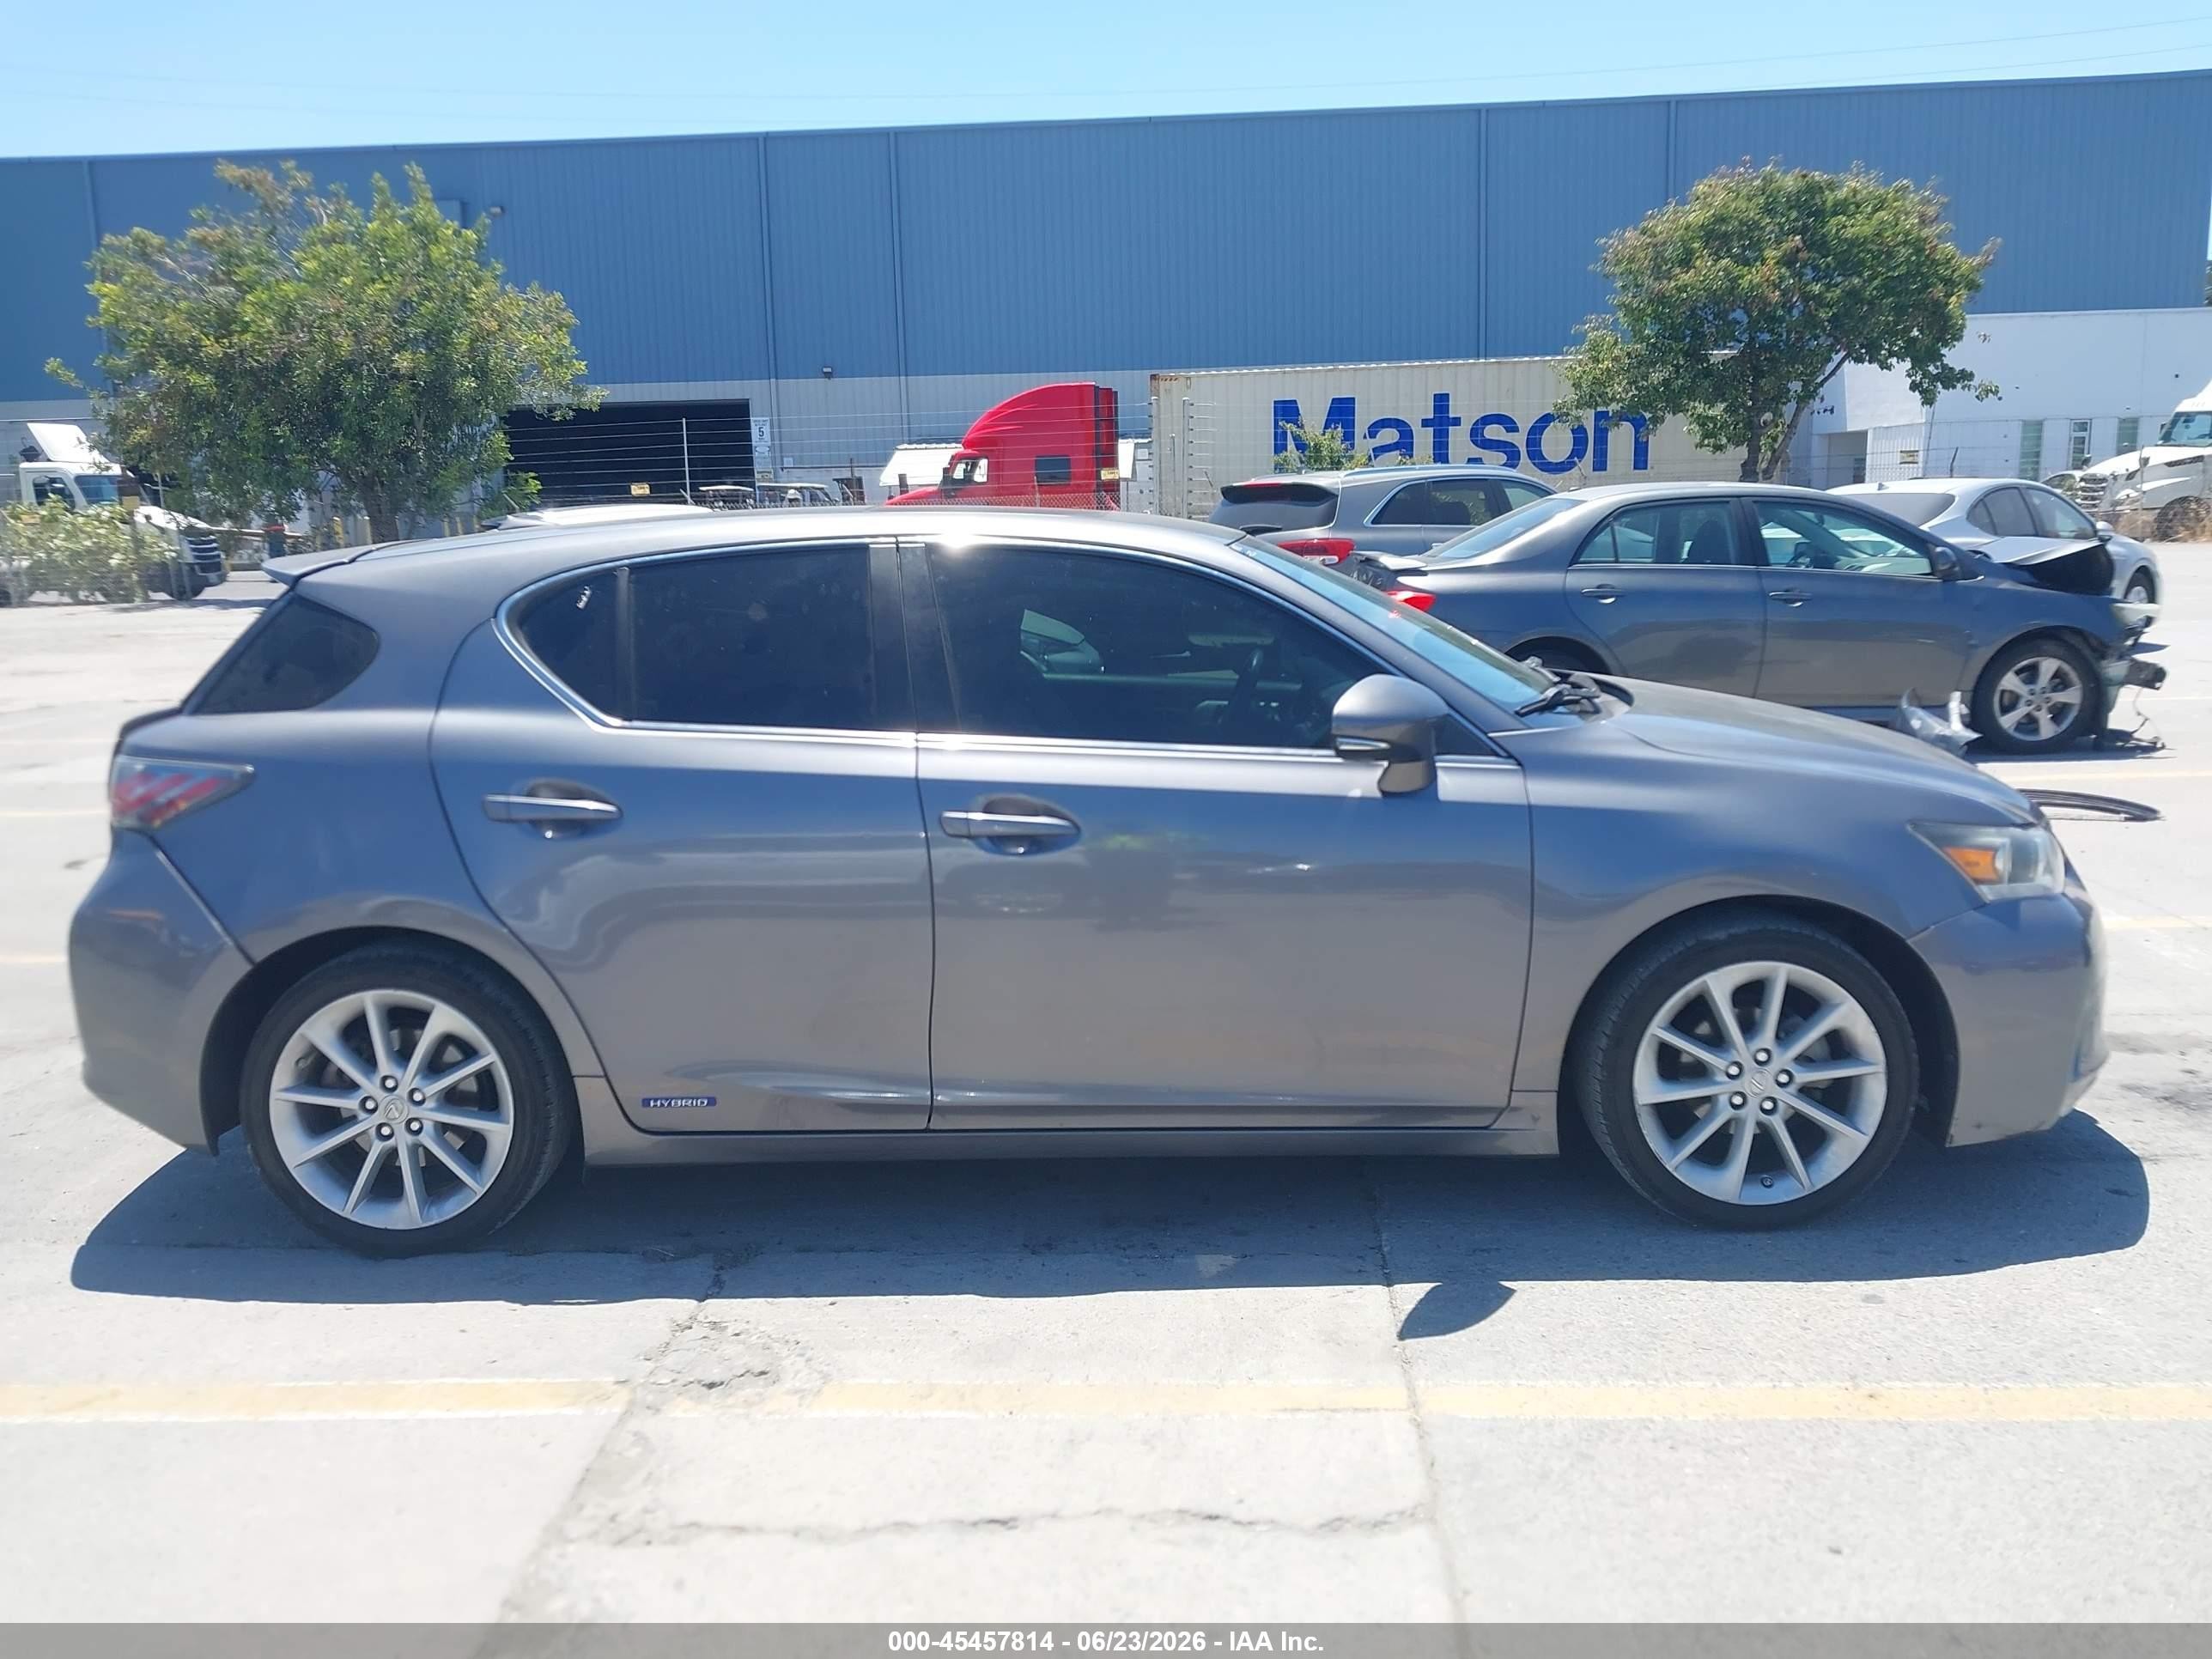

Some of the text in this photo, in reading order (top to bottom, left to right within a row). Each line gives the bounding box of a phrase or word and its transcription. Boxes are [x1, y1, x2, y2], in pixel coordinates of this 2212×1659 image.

[758, 426, 764, 437] 5
[1273, 392, 1650, 474] Matson
[650, 1098, 708, 1108] HYBRID
